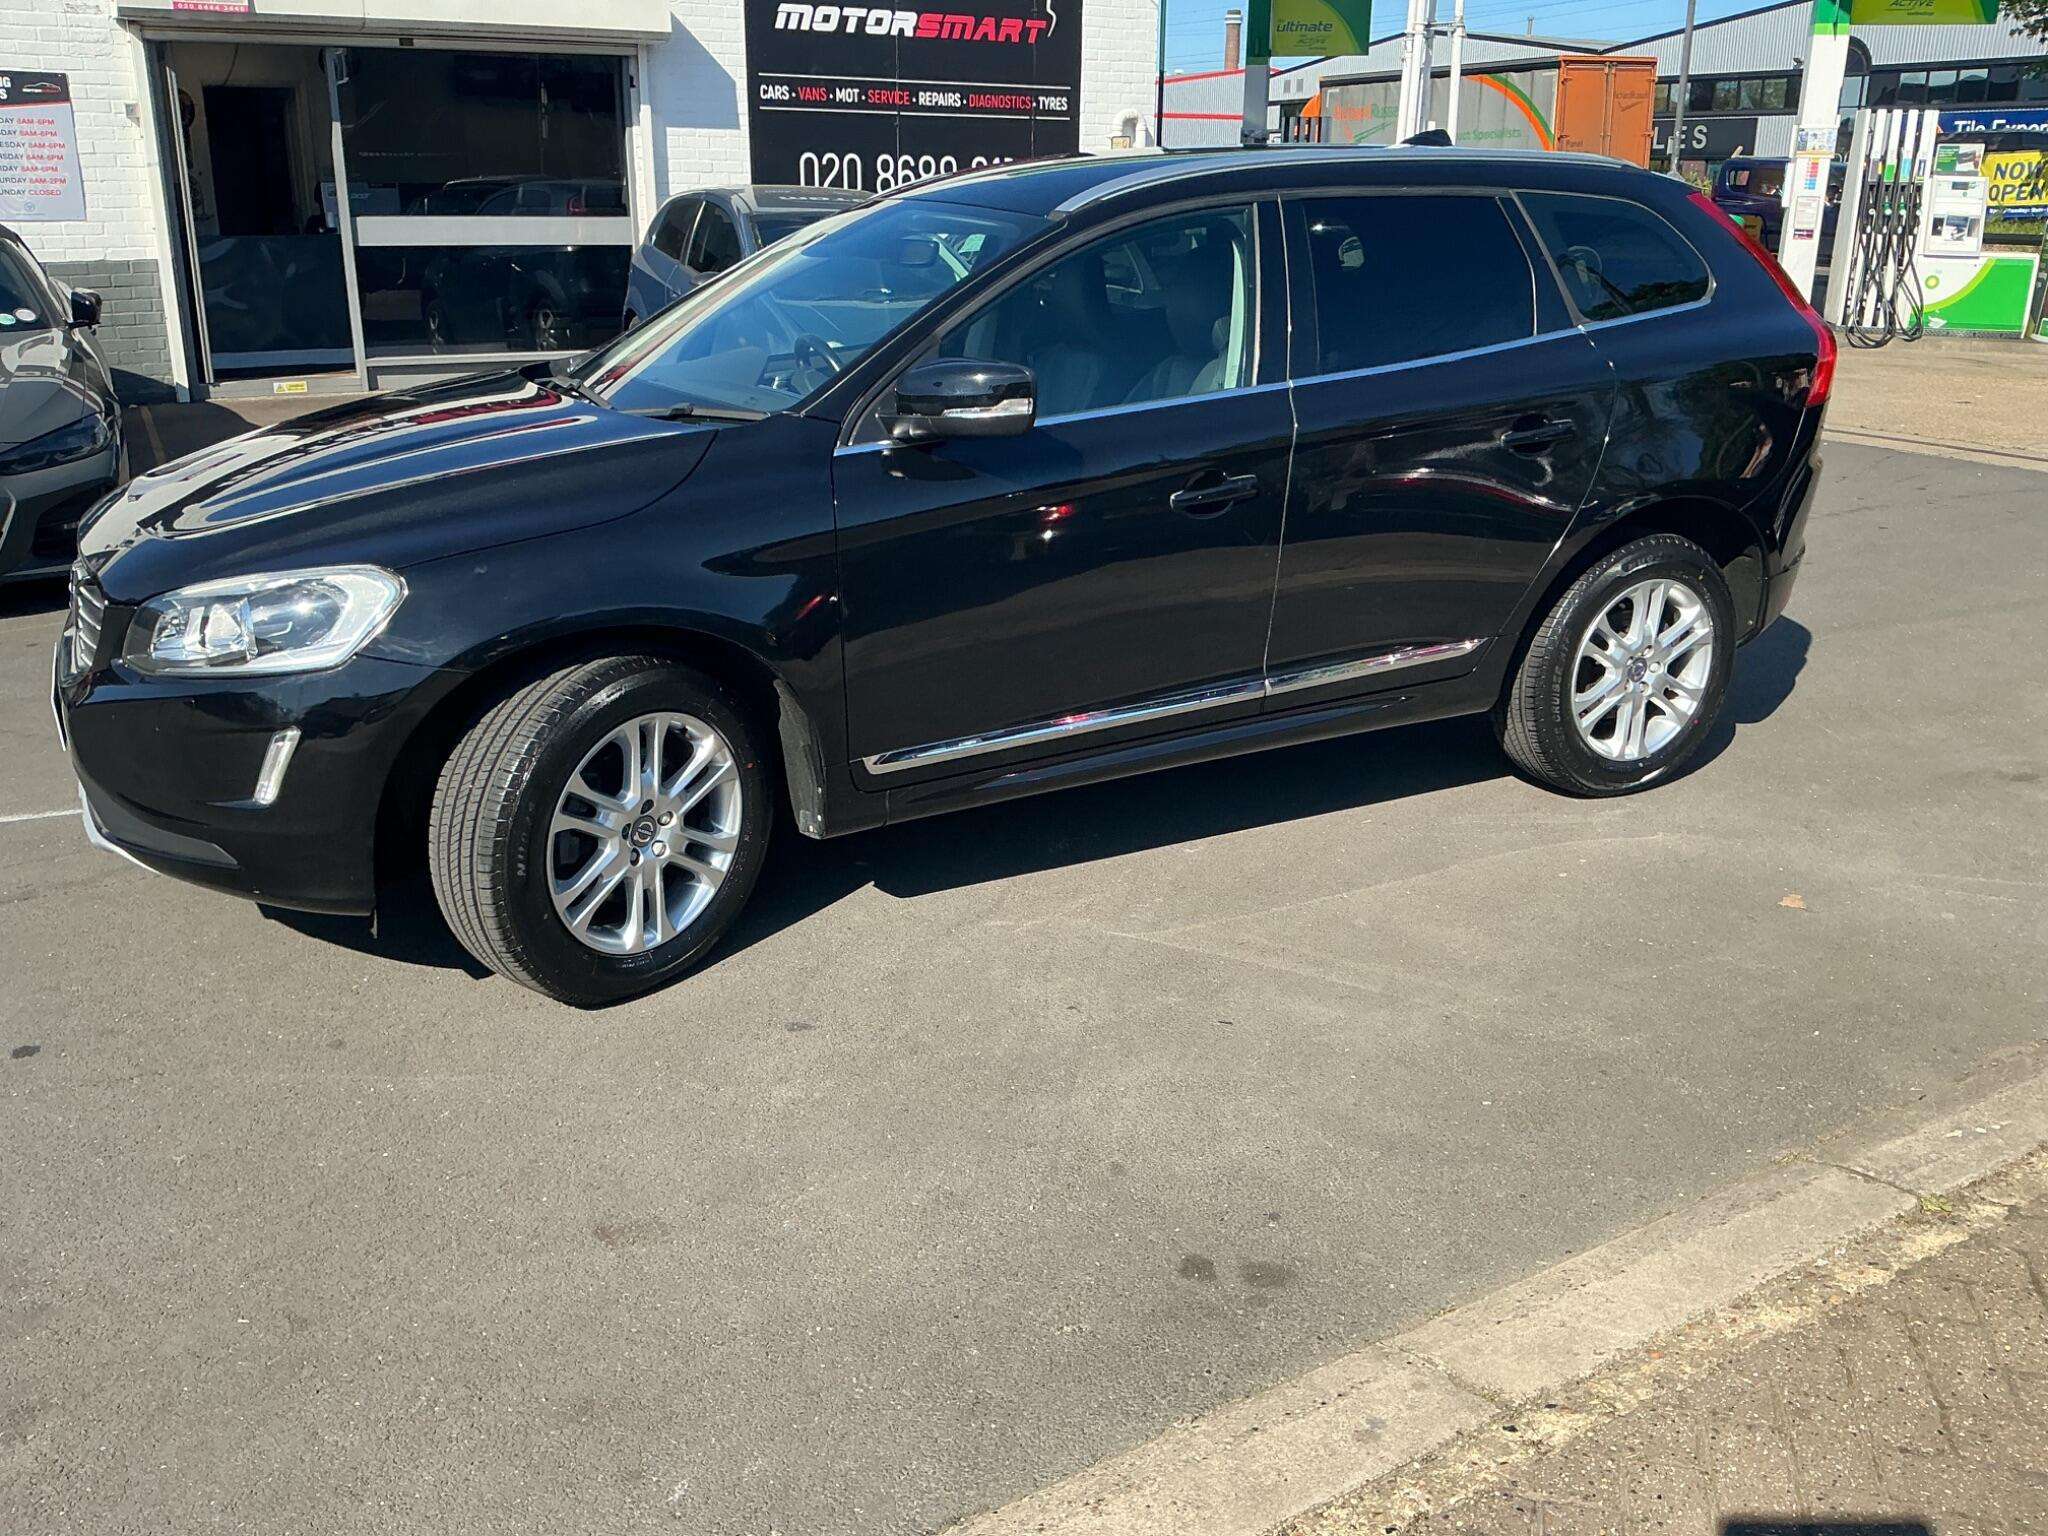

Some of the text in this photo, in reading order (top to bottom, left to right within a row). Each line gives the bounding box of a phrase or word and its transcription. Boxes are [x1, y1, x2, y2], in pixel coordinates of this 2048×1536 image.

[1276, 20, 1333, 32] ultimate
[760, 85, 1068, 111] CARS VANS MOT SERVICE REPAIRS DIAGNOSTICS TYRES
[800, 152, 862, 190] 020
